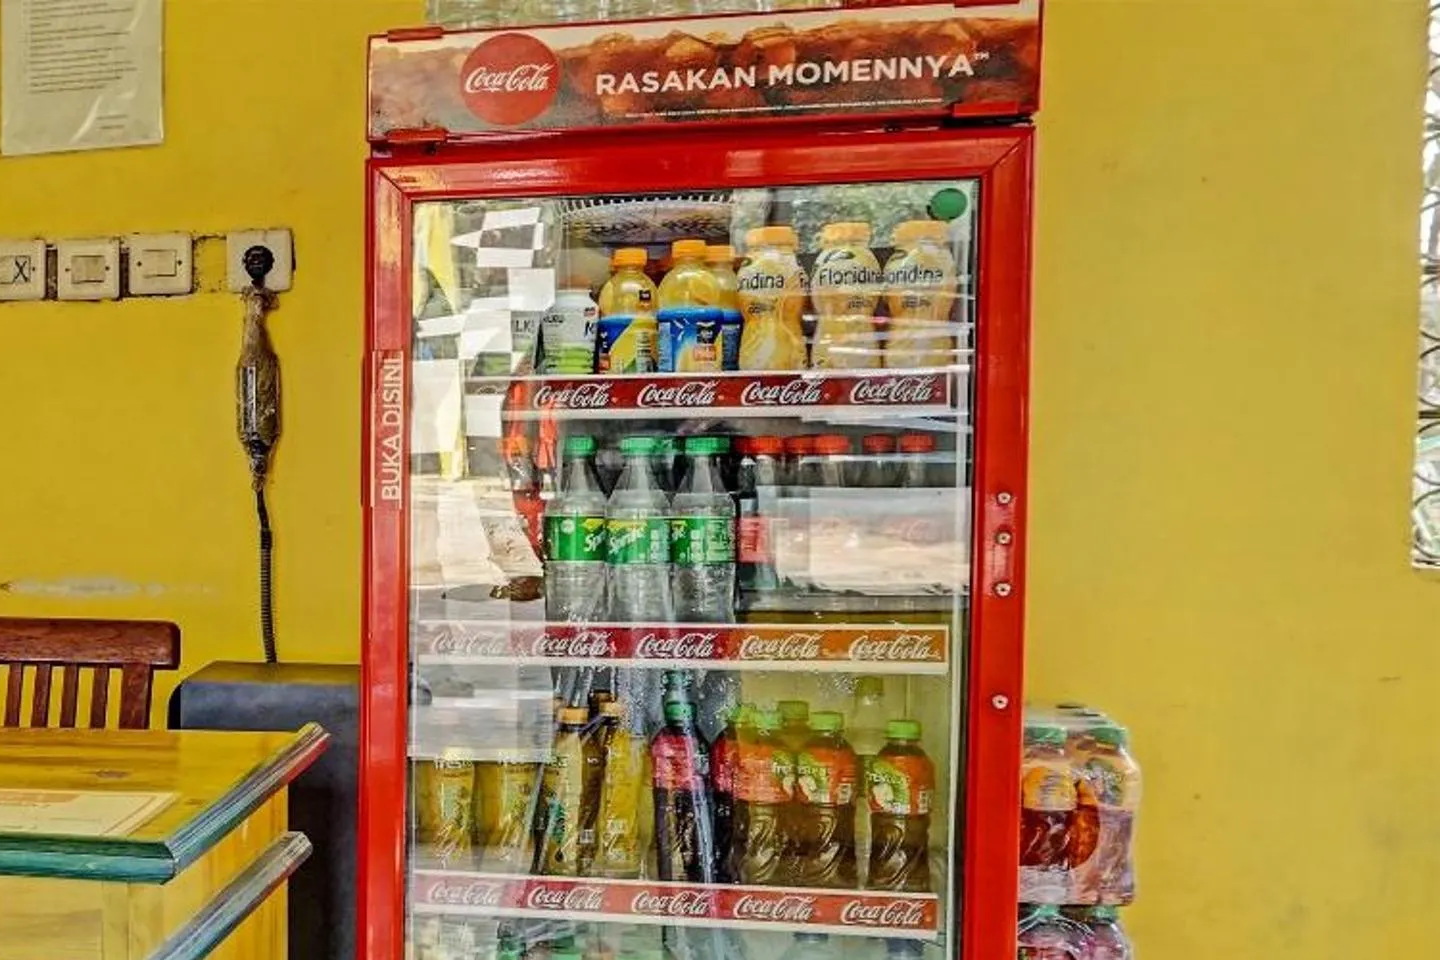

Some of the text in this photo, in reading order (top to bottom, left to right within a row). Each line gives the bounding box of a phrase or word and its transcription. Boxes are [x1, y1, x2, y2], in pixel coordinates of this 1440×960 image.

[465, 63, 555, 93] Coca-Cola
[596, 65, 757, 95] RASAKAN
[637, 380, 717, 406] Coca-Cola
[740, 377, 825, 405] Coca-Cola
[850, 375, 936, 405] Coca-Cola
[382, 358, 401, 500] BUKA DISINI
[637, 632, 718, 659] Coca-Cola
[739, 632, 825, 660] Coca-Cola
[848, 632, 934, 660] Coca-Cola
[630, 889, 711, 915] Coca-Cola
[733, 895, 818, 921] Coca-Cola
[840, 898, 926, 925] Coca-Cola
